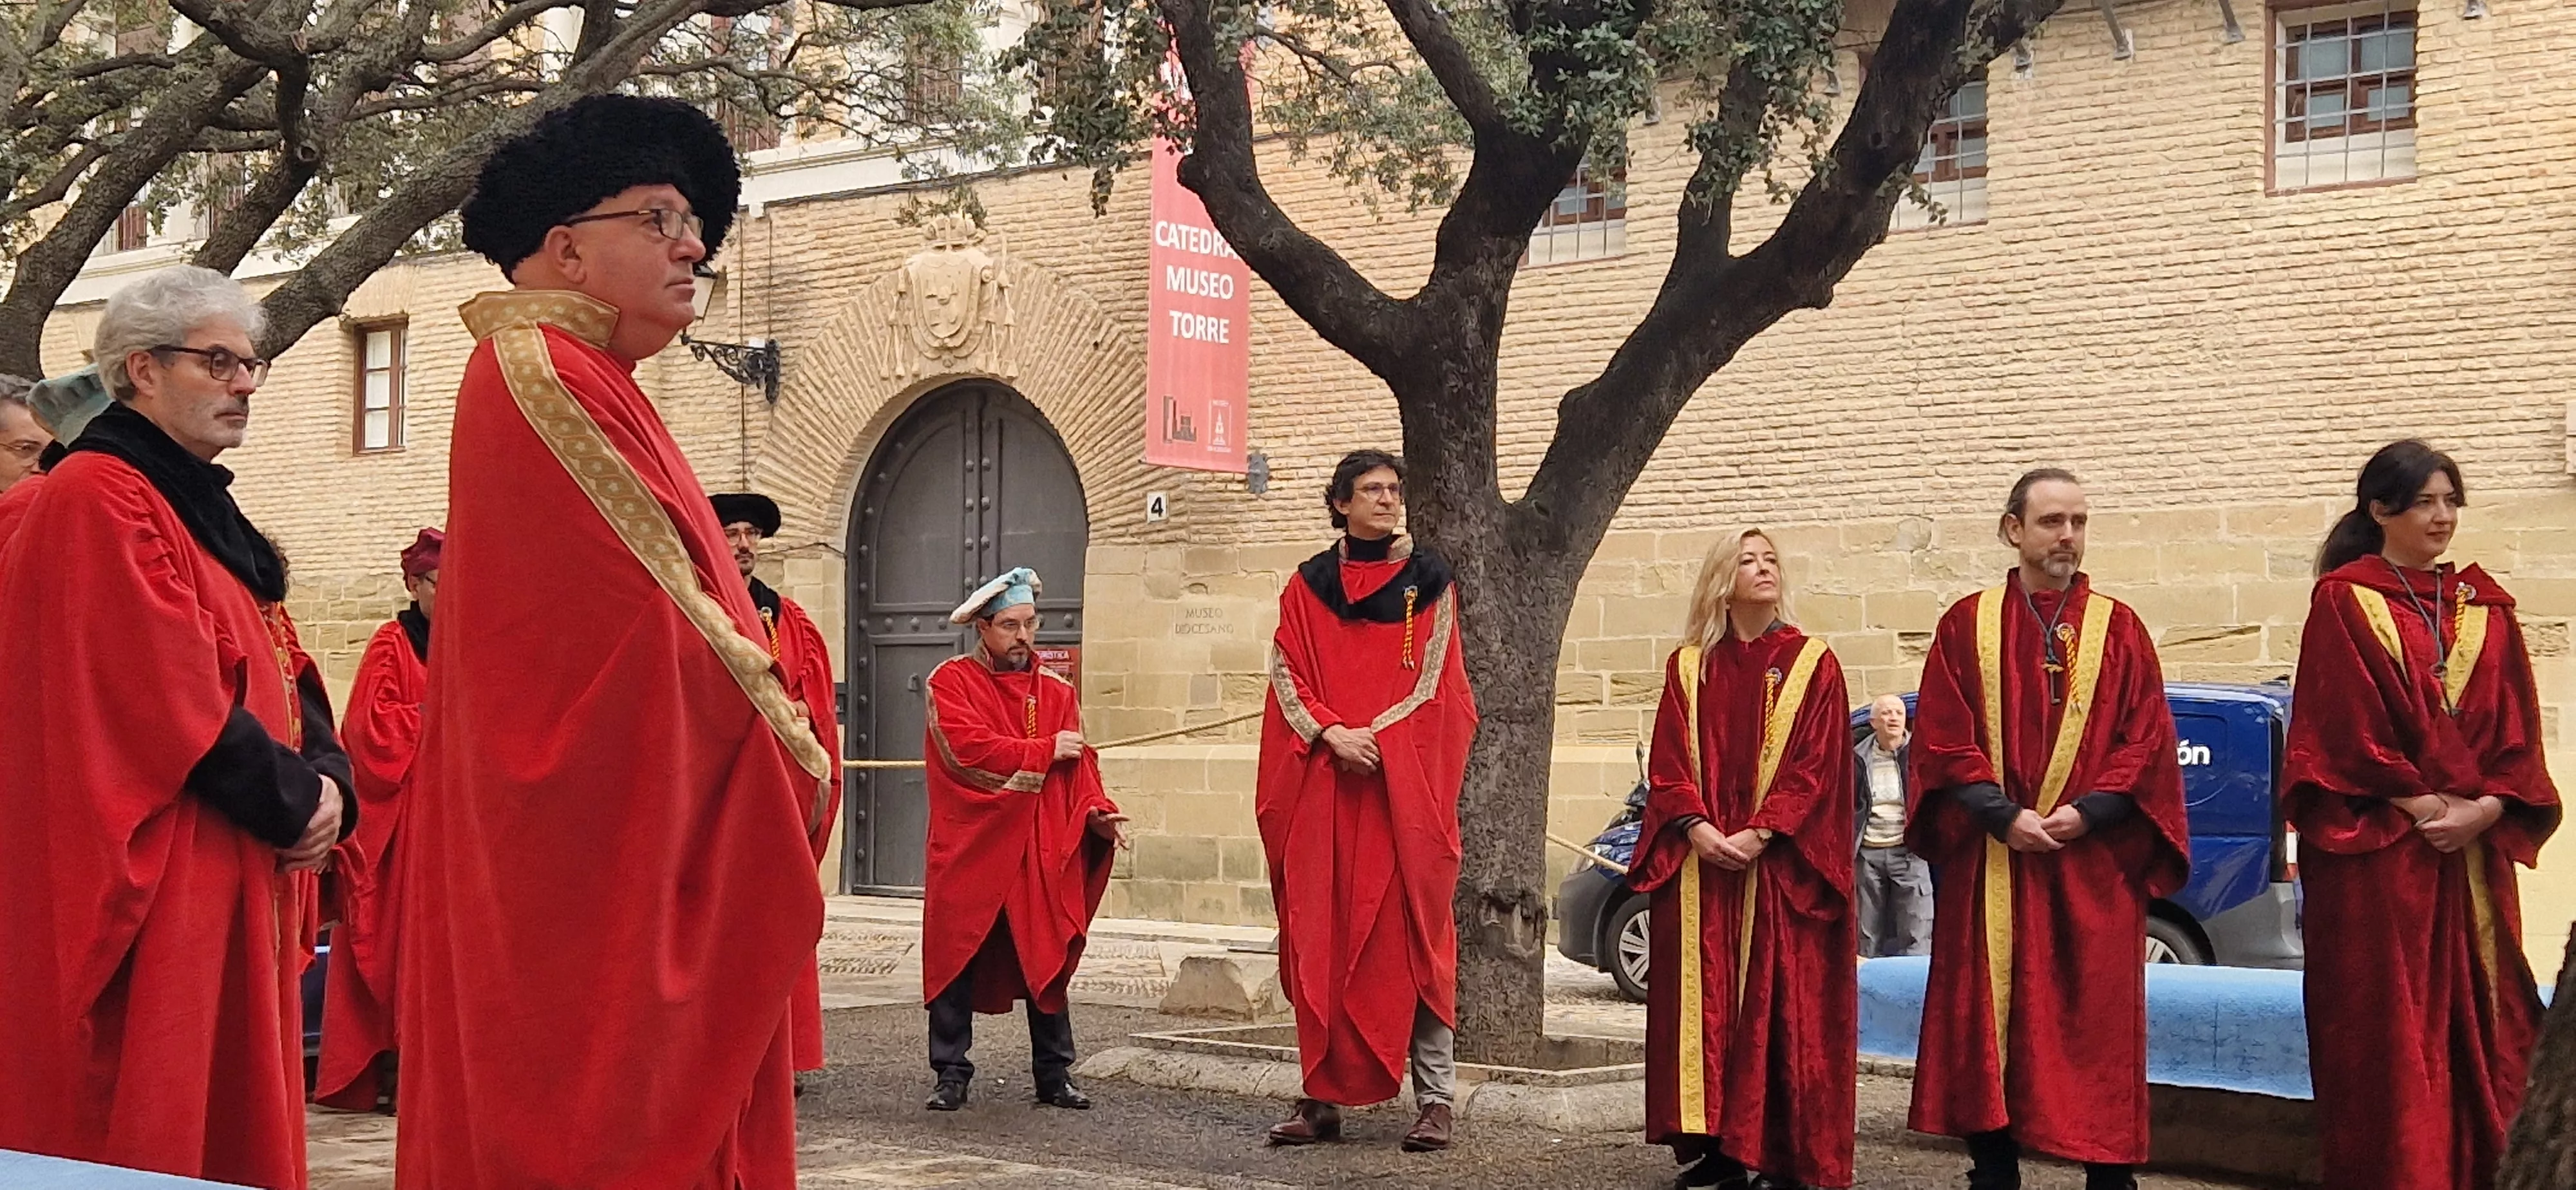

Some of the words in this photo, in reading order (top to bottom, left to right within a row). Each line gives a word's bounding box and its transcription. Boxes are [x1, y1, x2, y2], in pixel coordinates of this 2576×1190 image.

[1155, 221, 1240, 260] CATEDRA
[1166, 265, 1234, 299] MUSEO
[1170, 310, 1229, 344] TORRE
[1151, 496, 1164, 517] 4
[1186, 607, 1223, 618] MUSEO
[1175, 623, 1234, 634] DIOCESANO
[2177, 739, 2210, 765] ón
